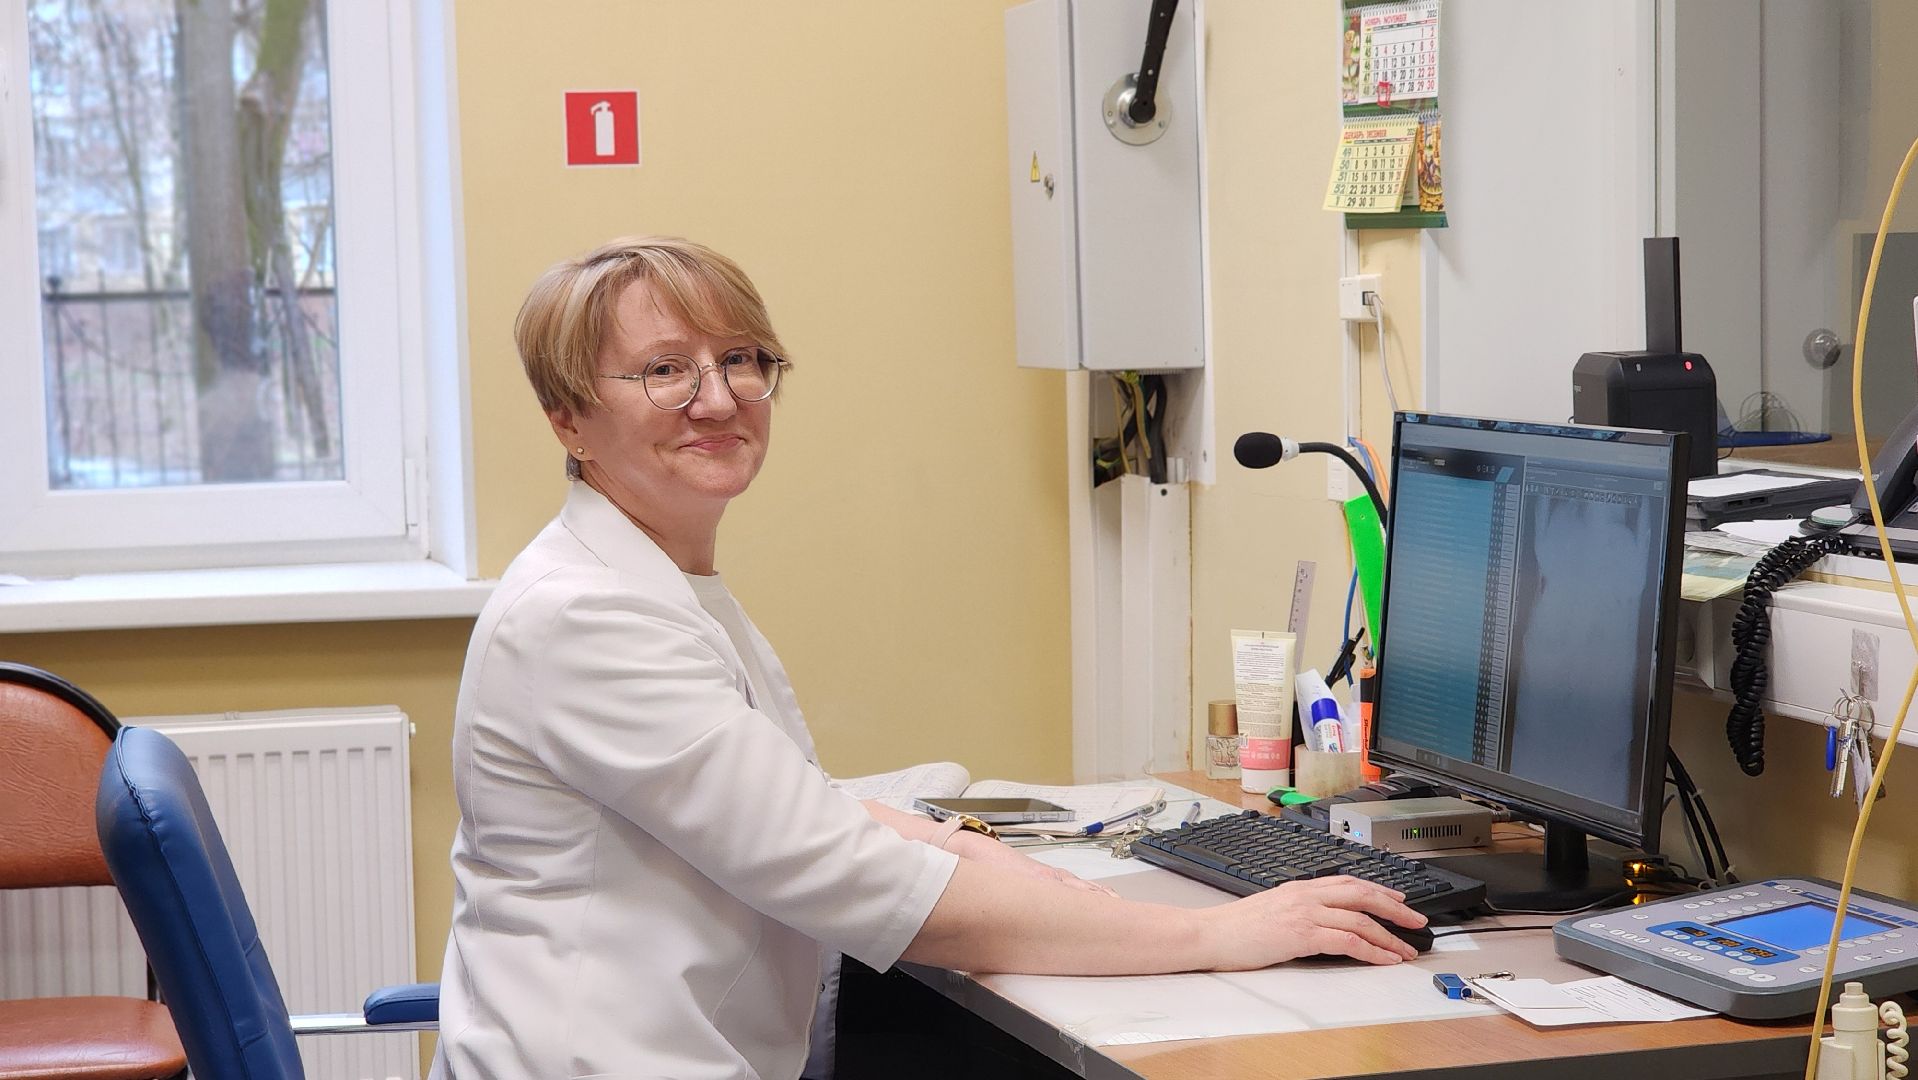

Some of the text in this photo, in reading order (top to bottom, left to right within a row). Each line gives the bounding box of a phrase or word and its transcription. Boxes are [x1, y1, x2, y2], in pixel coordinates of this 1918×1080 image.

[1384, 46, 1387, 55] 4
[1393, 45, 1396, 54] 5
[1402, 44, 1405, 53] 6
[1412, 43, 1414, 52] 7
[1374, 59, 1379, 69] 10
[1383, 58, 1388, 68] 11
[1392, 58, 1397, 68] 12
[1401, 57, 1406, 66] 13
[1410, 56, 1415, 65] 14
[1419, 55, 1424, 64] 15
[1429, 53, 1434, 62] 16
[1373, 72, 1379, 82] 17
[1382, 71, 1387, 81] 18
[1391, 71, 1396, 80] 19
[1400, 70, 1406, 80] 20
[1409, 69, 1415, 79] 21
[1418, 68, 1424, 78] 22
[1428, 67, 1434, 77] 23
[1399, 83, 1405, 92] 27
[1408, 82, 1414, 92] 28
[1417, 81, 1424, 91] 29
[1427, 80, 1434, 90] 30
[1364, 148, 1369, 156] 2
[1373, 147, 1377, 156] 3
[1382, 146, 1385, 156] 4
[1391, 145, 1395, 155] 5
[1364, 160, 1368, 169] 9
[1372, 159, 1378, 169] 10
[1381, 159, 1386, 168] 11
[1390, 159, 1395, 168] 12
[1352, 172, 1358, 182] 15
[1362, 172, 1368, 181] 16
[1371, 172, 1377, 181] 17
[1380, 172, 1385, 181] 18
[1389, 172, 1394, 181] 19
[1333, 184, 1346, 193] 52
[1349, 185, 1358, 194] 22
[1360, 185, 1367, 194] 23
[1370, 184, 1376, 194] 24
[1379, 184, 1385, 193] 25
[1387, 184, 1393, 193] 26
[1347, 197, 1357, 207] 29
[1359, 198, 1366, 207] 30
[1369, 198, 1376, 206] 31
